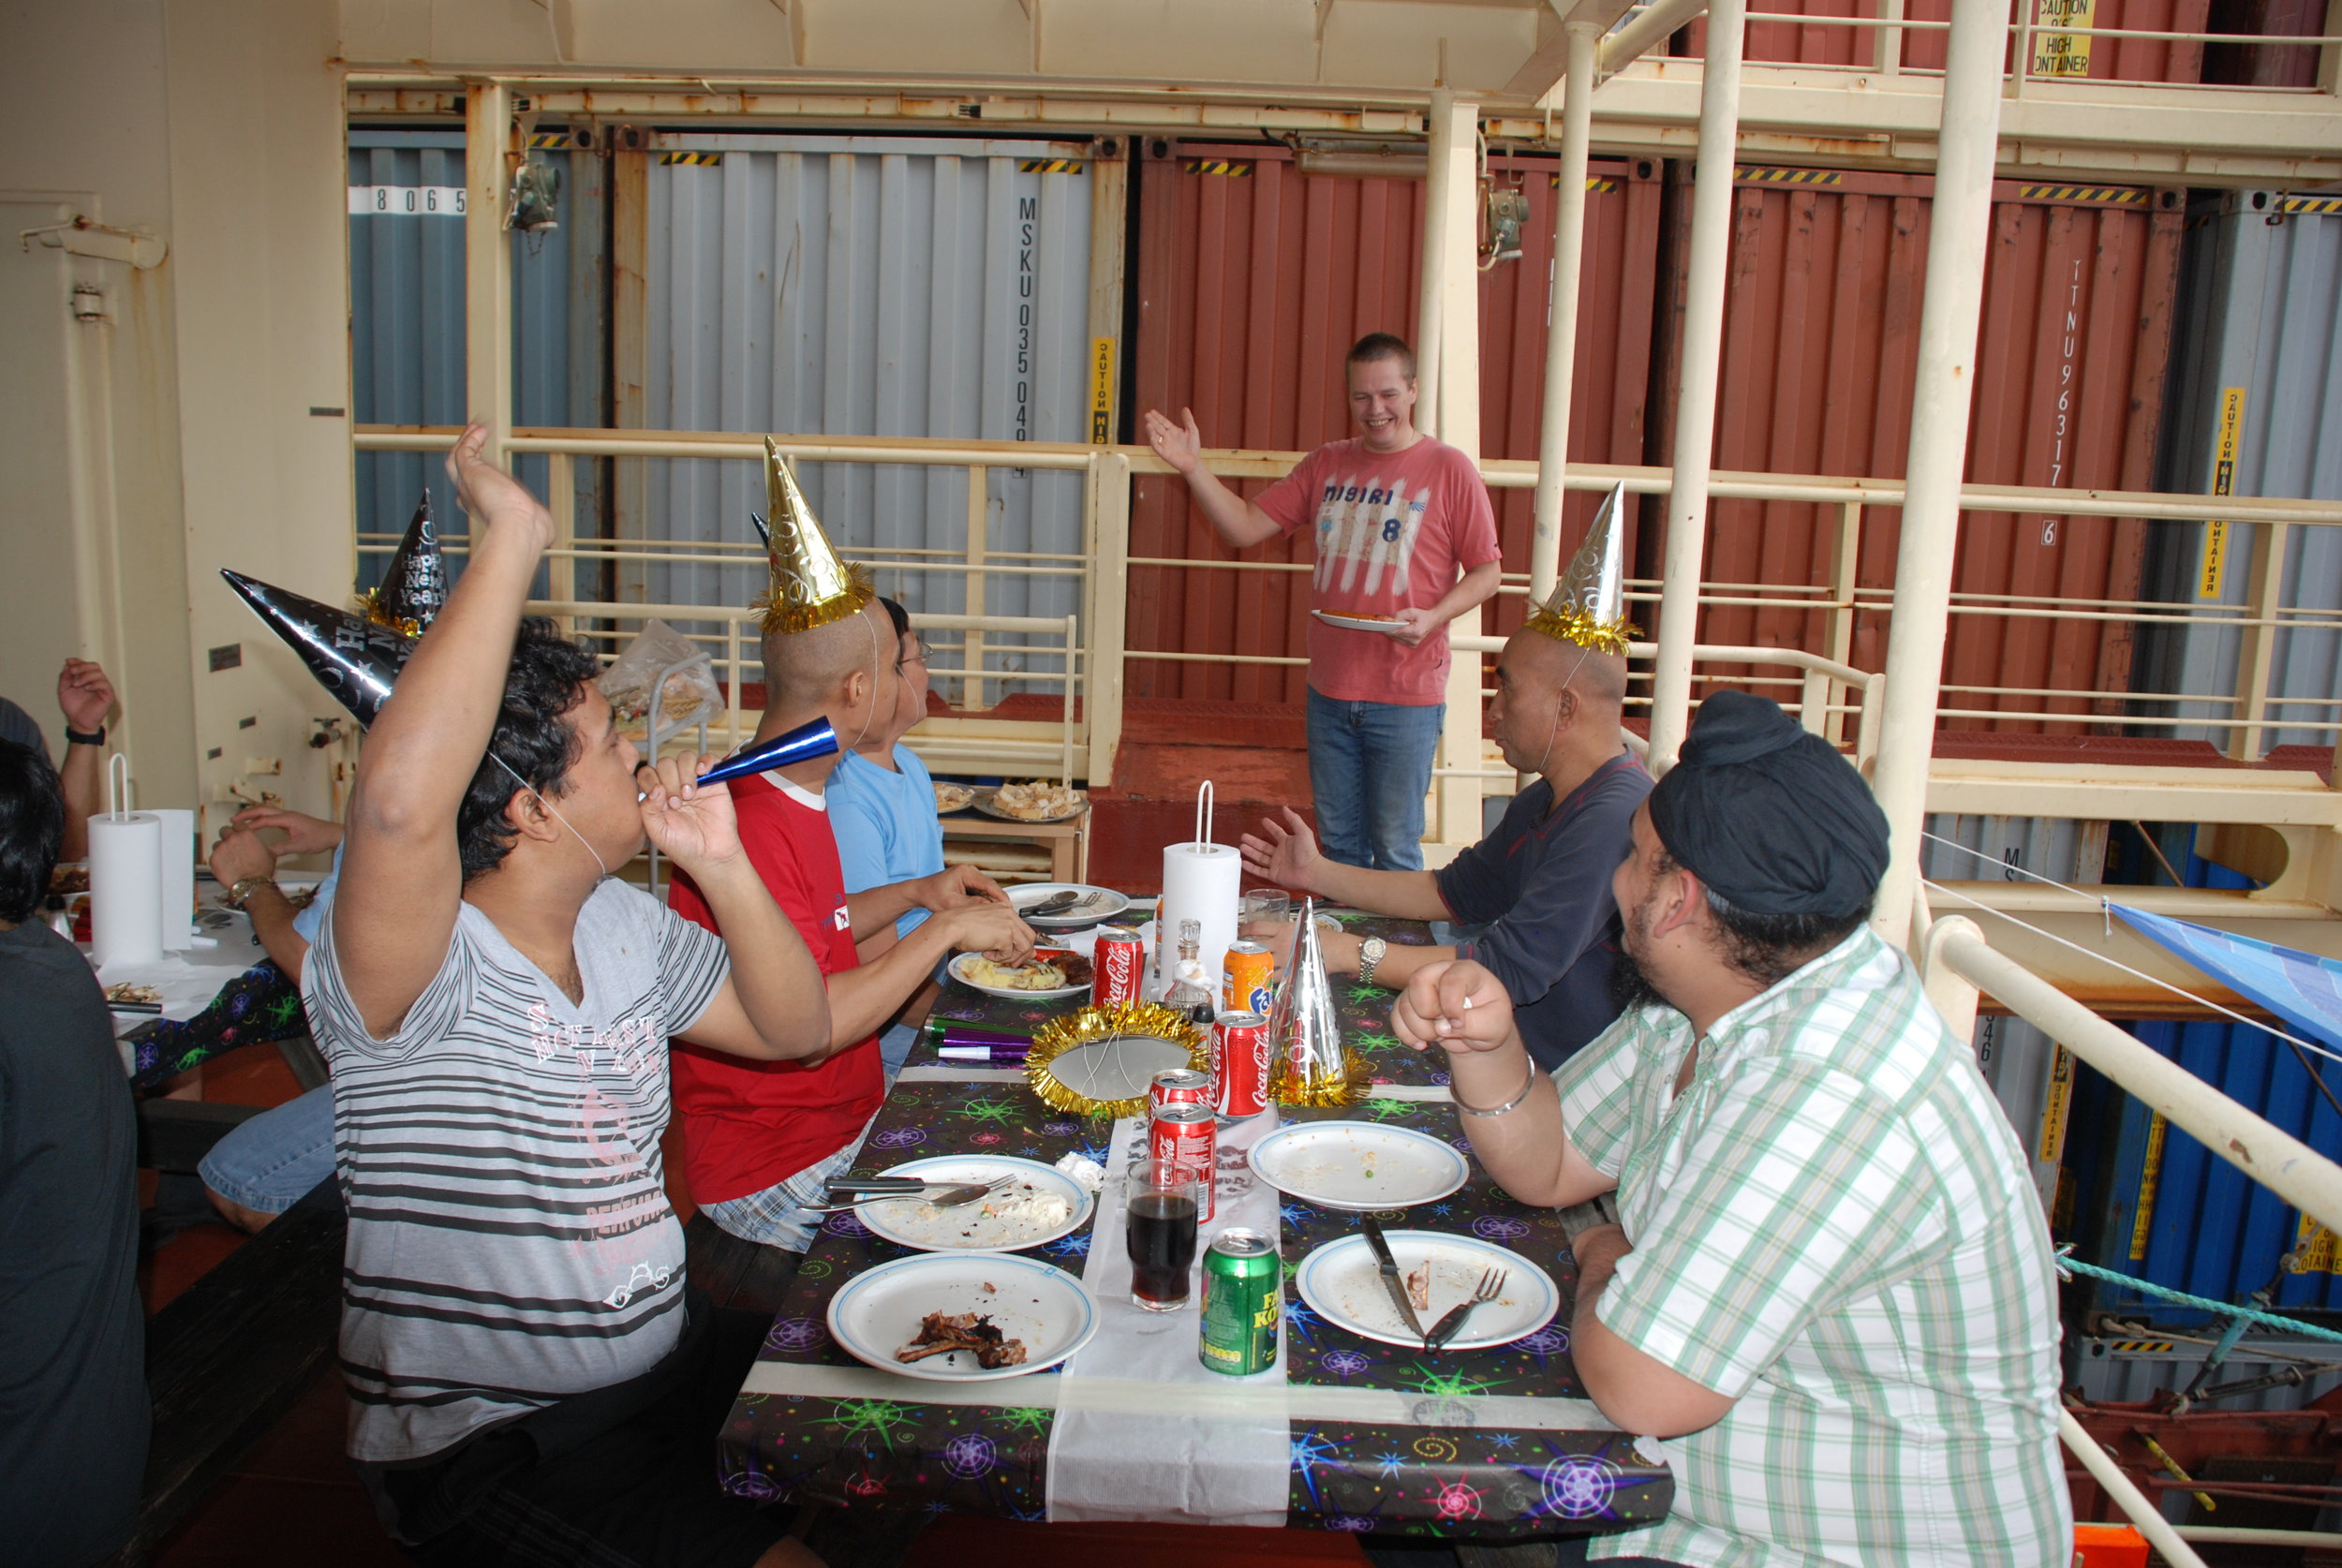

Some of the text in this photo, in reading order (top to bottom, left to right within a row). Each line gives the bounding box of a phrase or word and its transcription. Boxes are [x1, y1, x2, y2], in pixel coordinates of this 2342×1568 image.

[2046, 37, 2072, 53] HIGH
[2035, 55, 2088, 73] ONTAINER
[1019, 198, 1036, 298] MSKU
[1018, 303, 1030, 374] 035
[1382, 518, 1401, 543] 8
